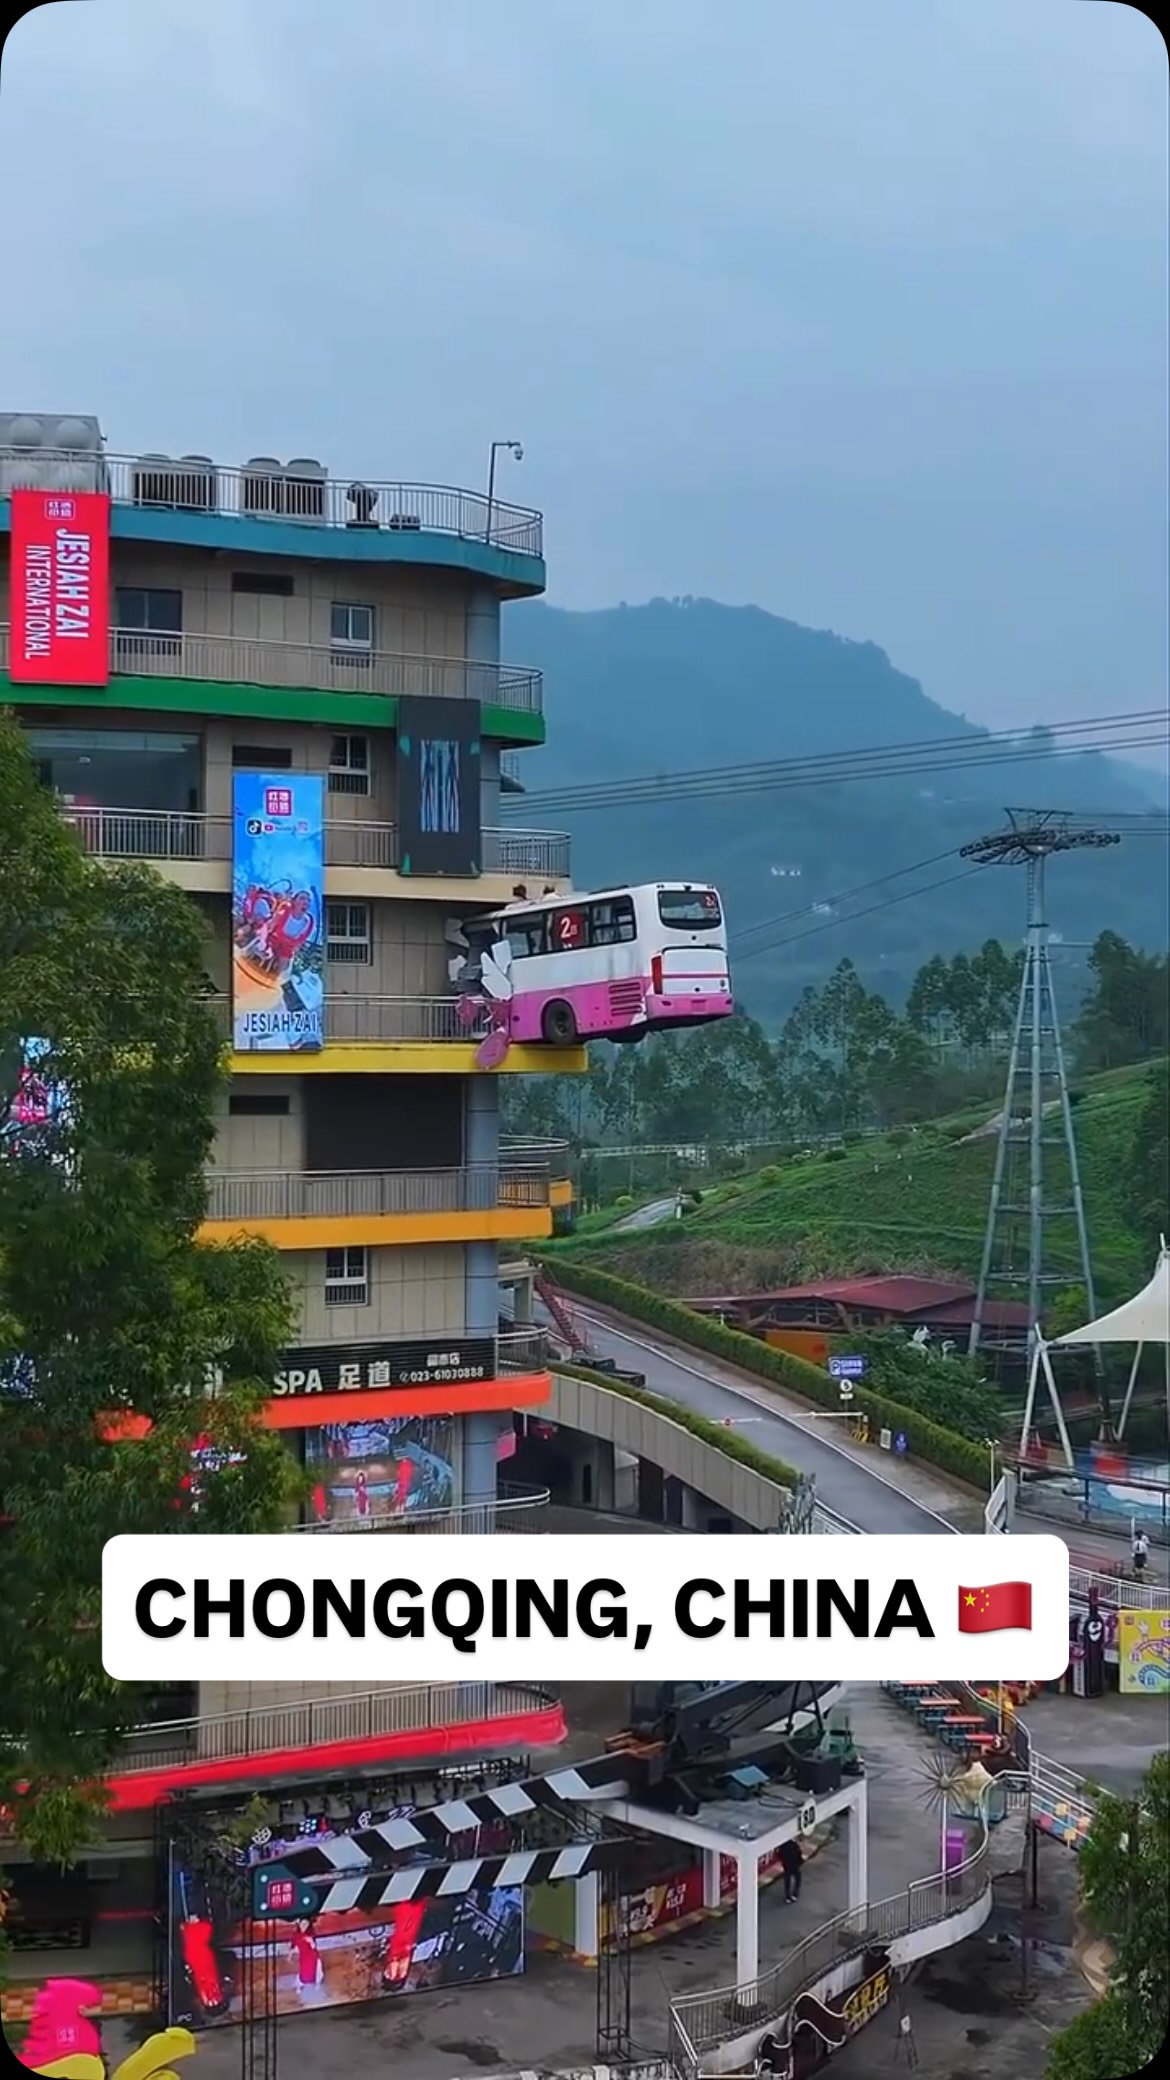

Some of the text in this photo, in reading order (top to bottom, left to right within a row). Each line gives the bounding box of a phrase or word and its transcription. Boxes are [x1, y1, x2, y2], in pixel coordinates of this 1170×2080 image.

[55, 527, 91, 600] JESIAH
[25, 544, 52, 660] INTERNATIONAL
[55, 603, 90, 637] ZAI
[243, 1012, 316, 1034] JESIAH ZAI
[272, 1360, 391, 1396] SPA 足道
